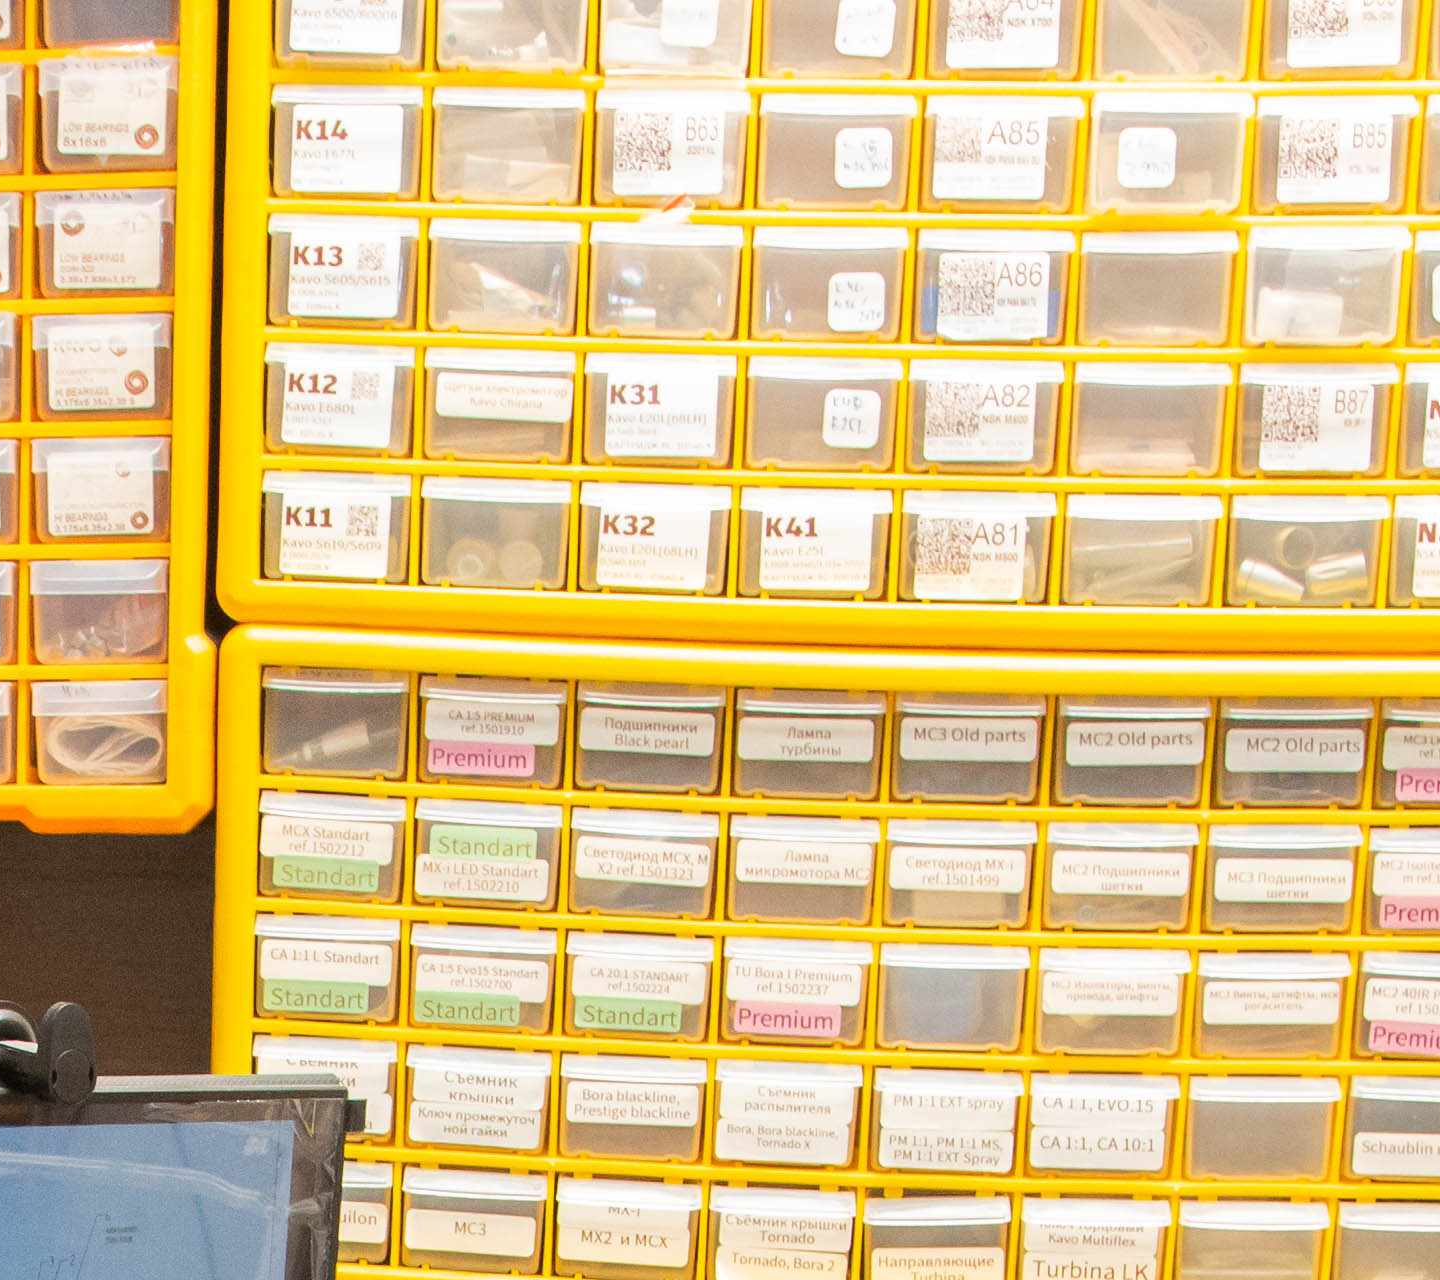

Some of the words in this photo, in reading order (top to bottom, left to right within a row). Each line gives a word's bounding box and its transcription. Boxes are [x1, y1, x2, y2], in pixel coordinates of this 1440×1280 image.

[295, 119, 348, 140] K14
[986, 120, 1039, 146] A85
[1352, 123, 1386, 149] B85
[293, 245, 342, 267] K13
[996, 262, 1042, 287] A86
[288, 373, 337, 394] K12
[610, 384, 660, 405] K31
[978, 383, 1030, 409] A82
[285, 506, 332, 528] K11
[602, 514, 655, 536] K32
[765, 517, 817, 537] K41
[969, 522, 1017, 546] A81
[604, 716, 698, 733] Подшипники
[786, 725, 832, 739] Лампа
[614, 733, 650, 747] Black
[654, 736, 688, 749] pearl
[913, 727, 947, 740] MC3
[951, 727, 980, 741] Old
[984, 729, 1026, 745] parts
[1079, 731, 1113, 746] MC2
[1117, 731, 1146, 746] Old
[1150, 732, 1193, 749] parts
[432, 744, 526, 768] Premium
[780, 742, 841, 756] турбины
[437, 835, 532, 858] Standart
[271, 988, 363, 1010] Standart
[583, 1005, 678, 1027] Standart
[738, 1007, 832, 1030] Premium
[582, 1088, 613, 1101] Bora
[574, 1103, 627, 1120] Prestige
[630, 1104, 691, 1120] blackline
[1361, 1141, 1433, 1155] Schaublin
[454, 1220, 486, 1236] MC3
[580, 1229, 612, 1244] MX2
[1033, 1259, 1114, 1280] Turbina
[1122, 1263, 1148, 1280] LK
